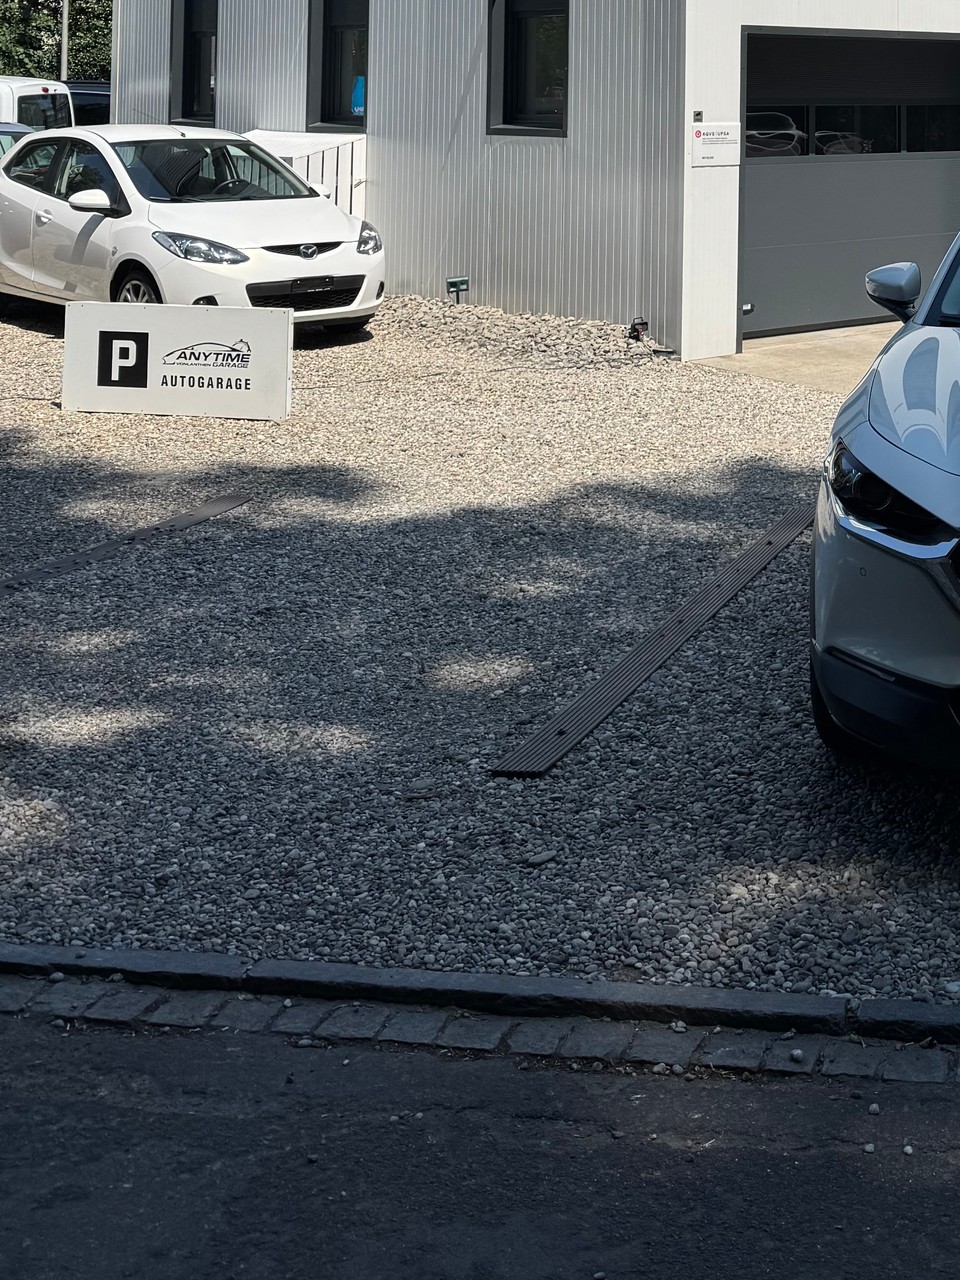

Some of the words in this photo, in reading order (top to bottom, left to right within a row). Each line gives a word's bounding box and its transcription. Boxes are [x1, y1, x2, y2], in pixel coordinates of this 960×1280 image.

[111, 339, 137, 381] P
[176, 351, 251, 363] ANYTIME
[161, 374, 251, 390] AUTOGARAGE
